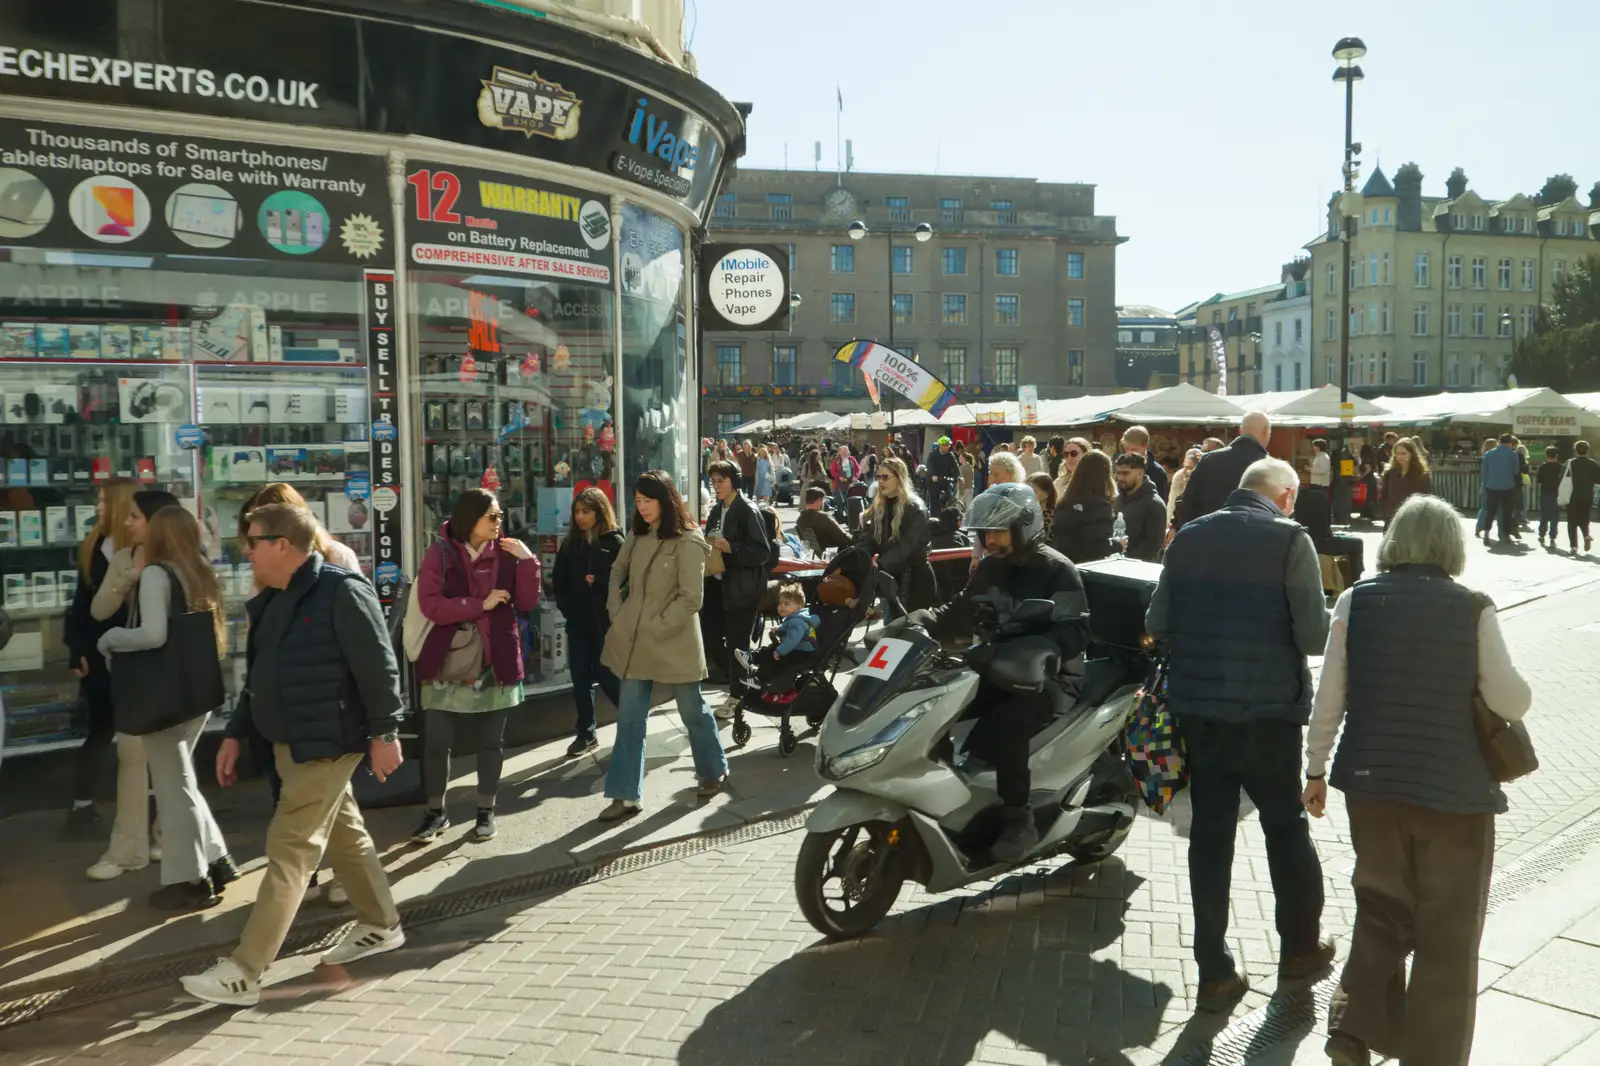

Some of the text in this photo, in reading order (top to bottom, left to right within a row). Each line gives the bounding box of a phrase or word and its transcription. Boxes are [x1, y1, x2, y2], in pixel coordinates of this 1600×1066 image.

[0, 45, 319, 109] ECHEXPERTS.CO.UK
[488, 85, 574, 125] VAPE
[512, 117, 545, 129] SHOP
[25, 128, 328, 172] Thousands of Smartphones/
[157, 161, 186, 178] for
[190, 164, 234, 182] Sale
[238, 171, 279, 187] with
[282, 172, 366, 197] Warranty
[617, 155, 689, 194] E-Vape Specialist
[407, 169, 461, 224] 12
[478, 180, 581, 223] WARRANTY
[447, 230, 590, 259] on Battery Replacement
[415, 247, 609, 281] COMPREHENSIVE AFTER SALE SERVICE
[720, 258, 769, 271] iMobile
[724, 272, 765, 286] Repair
[725, 288, 772, 299] Phones
[13, 283, 122, 309] APPLE
[231, 290, 328, 312] APPLE
[374, 283, 388, 325] BUY
[725, 303, 757, 316] Vape
[376, 332, 389, 391] SELL
[882, 353, 919, 382] 100%
[875, 369, 912, 396] COFFEE
[1516, 414, 1577, 426] COFFEE BEANS
[379, 398, 394, 484] TRDES
[867, 645, 889, 670] L
